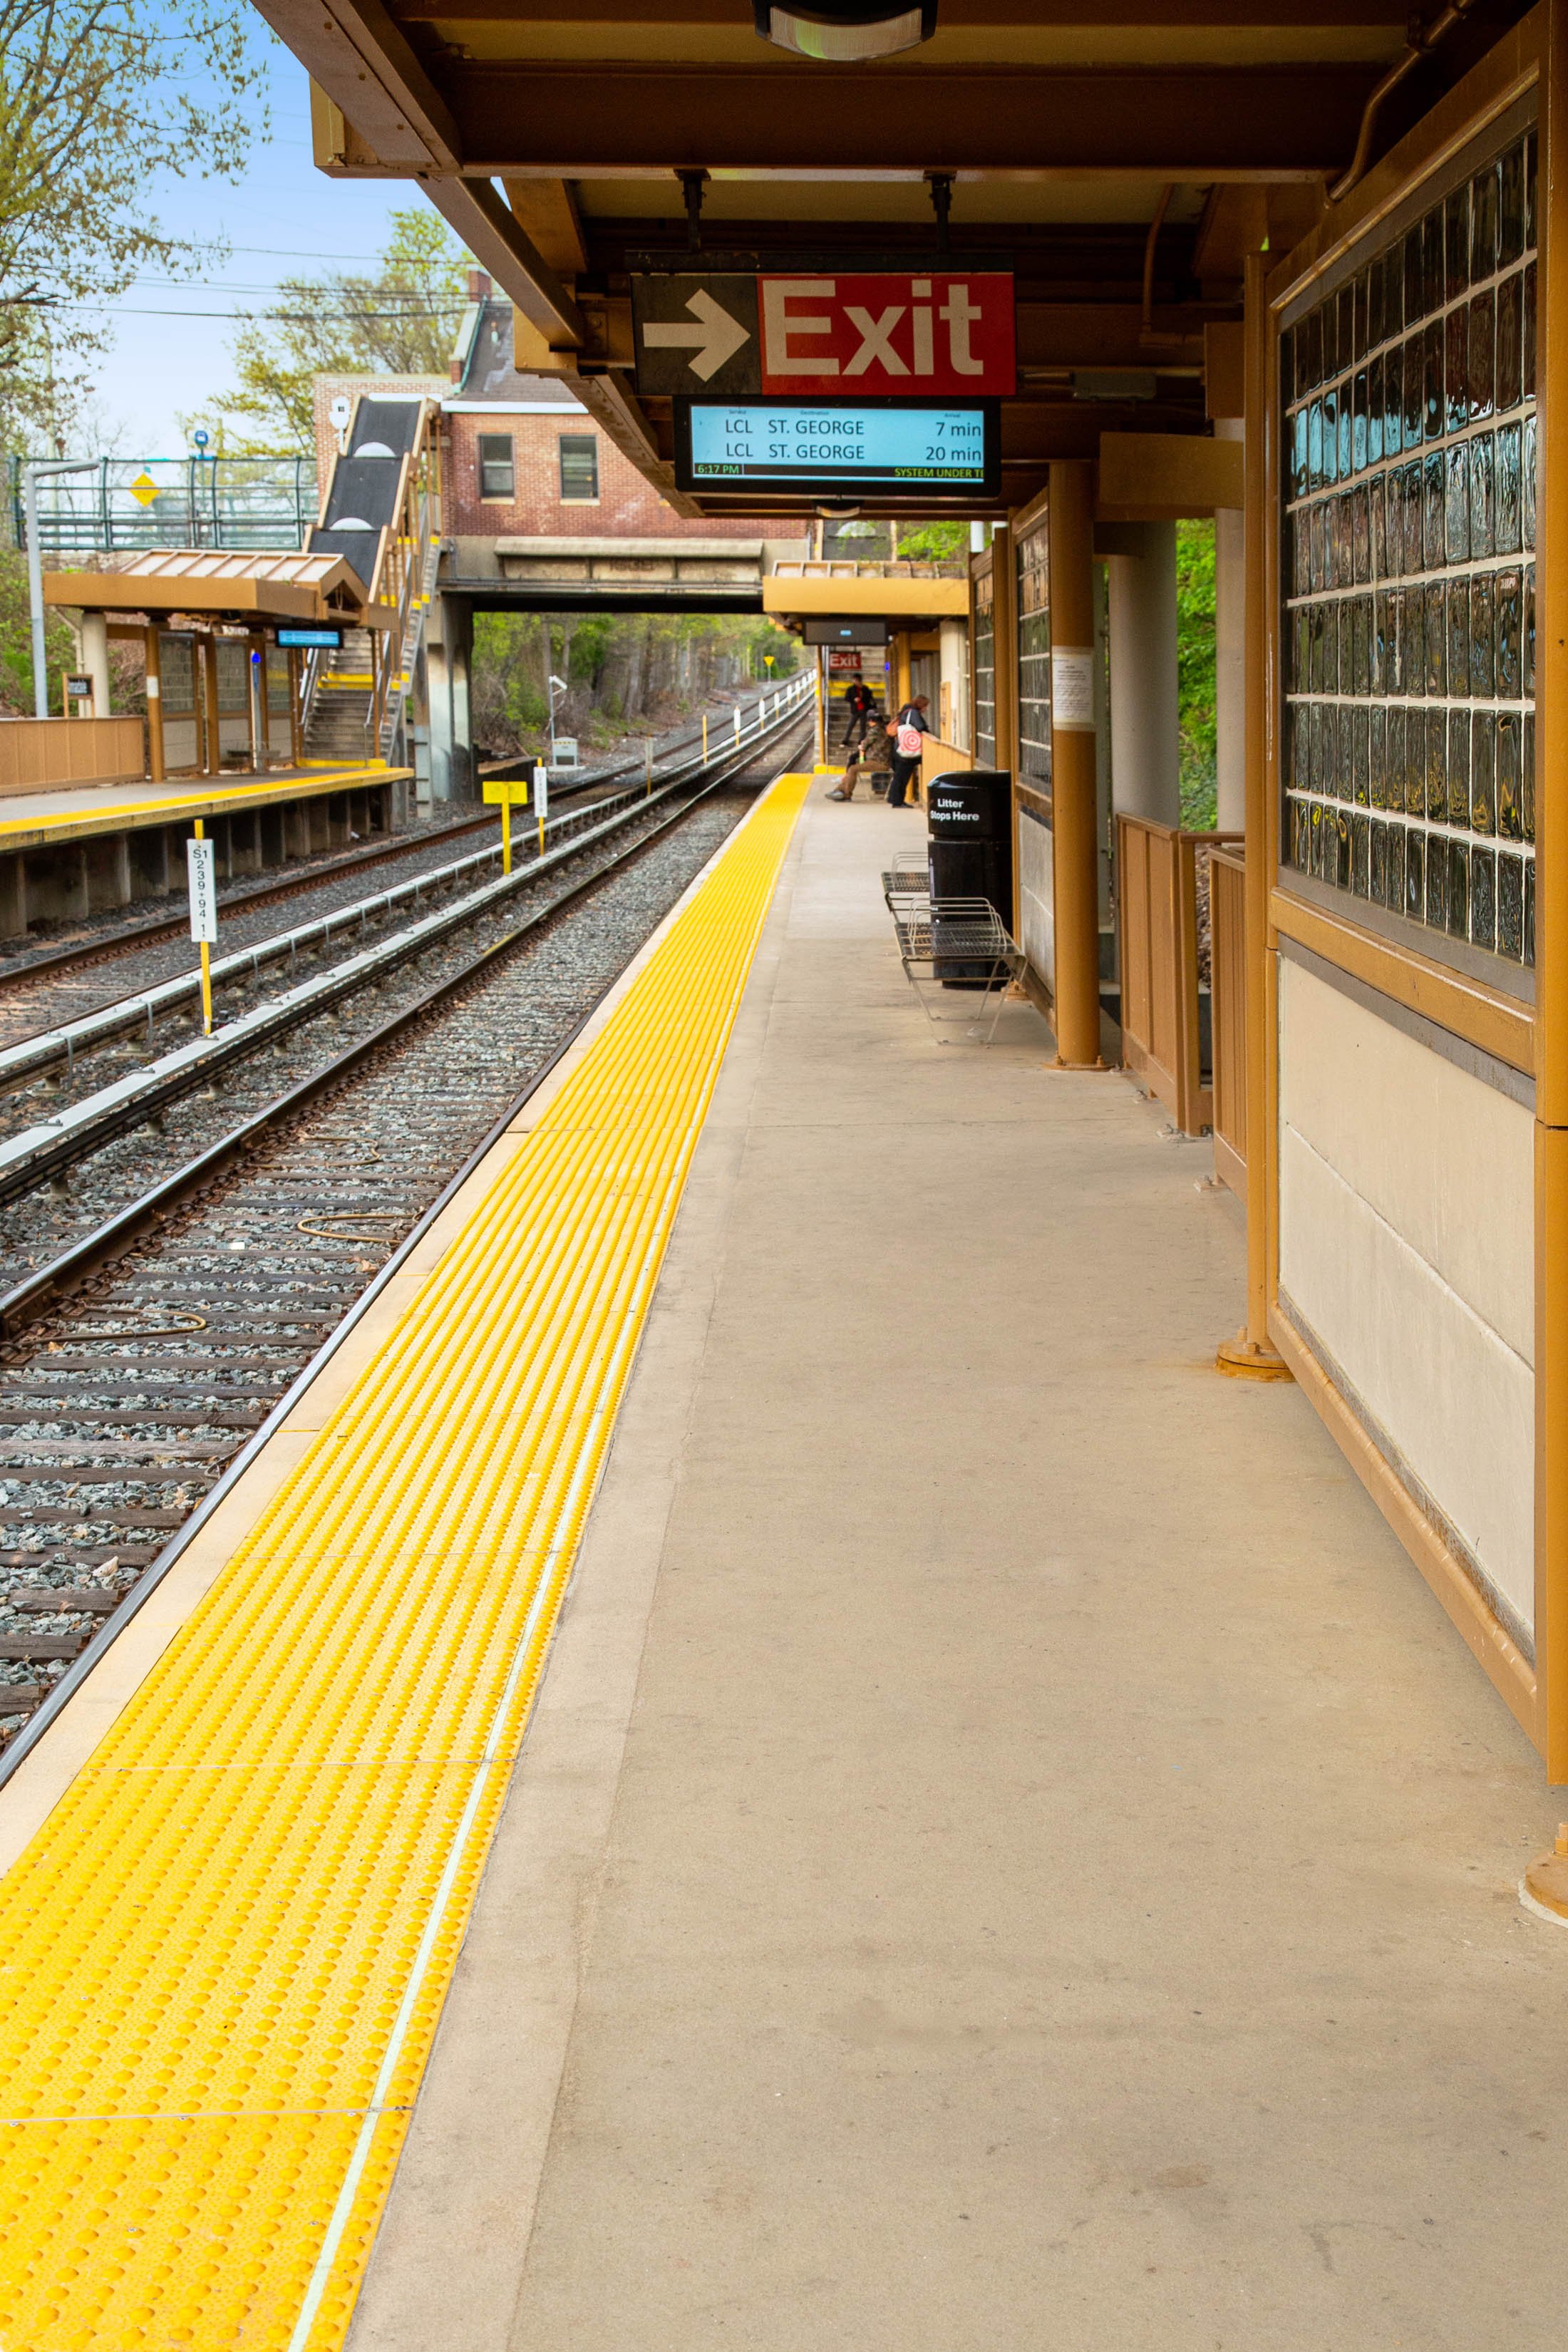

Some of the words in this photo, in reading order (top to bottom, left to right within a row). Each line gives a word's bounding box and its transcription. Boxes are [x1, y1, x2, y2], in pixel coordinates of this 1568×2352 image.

[762, 279, 984, 376] Exit
[726, 419, 753, 433] LCL
[768, 419, 790, 434] ST.
[795, 420, 865, 435] GEORGE
[936, 422, 945, 436] 7
[951, 422, 981, 436] min
[726, 443, 753, 457] LCL
[768, 444, 790, 458] ST.
[795, 444, 865, 459] GEORGE
[926, 446, 946, 460] 20
[951, 447, 981, 460] min
[698, 465, 720, 474] 6:17
[722, 465, 739, 474] PM
[894, 468, 934, 477] SYSTEM
[937, 468, 972, 478] UNDER
[830, 653, 858, 667] Exit
[937, 798, 964, 808] Litter
[930, 810, 951, 821] Stops
[952, 811, 980, 821] Here
